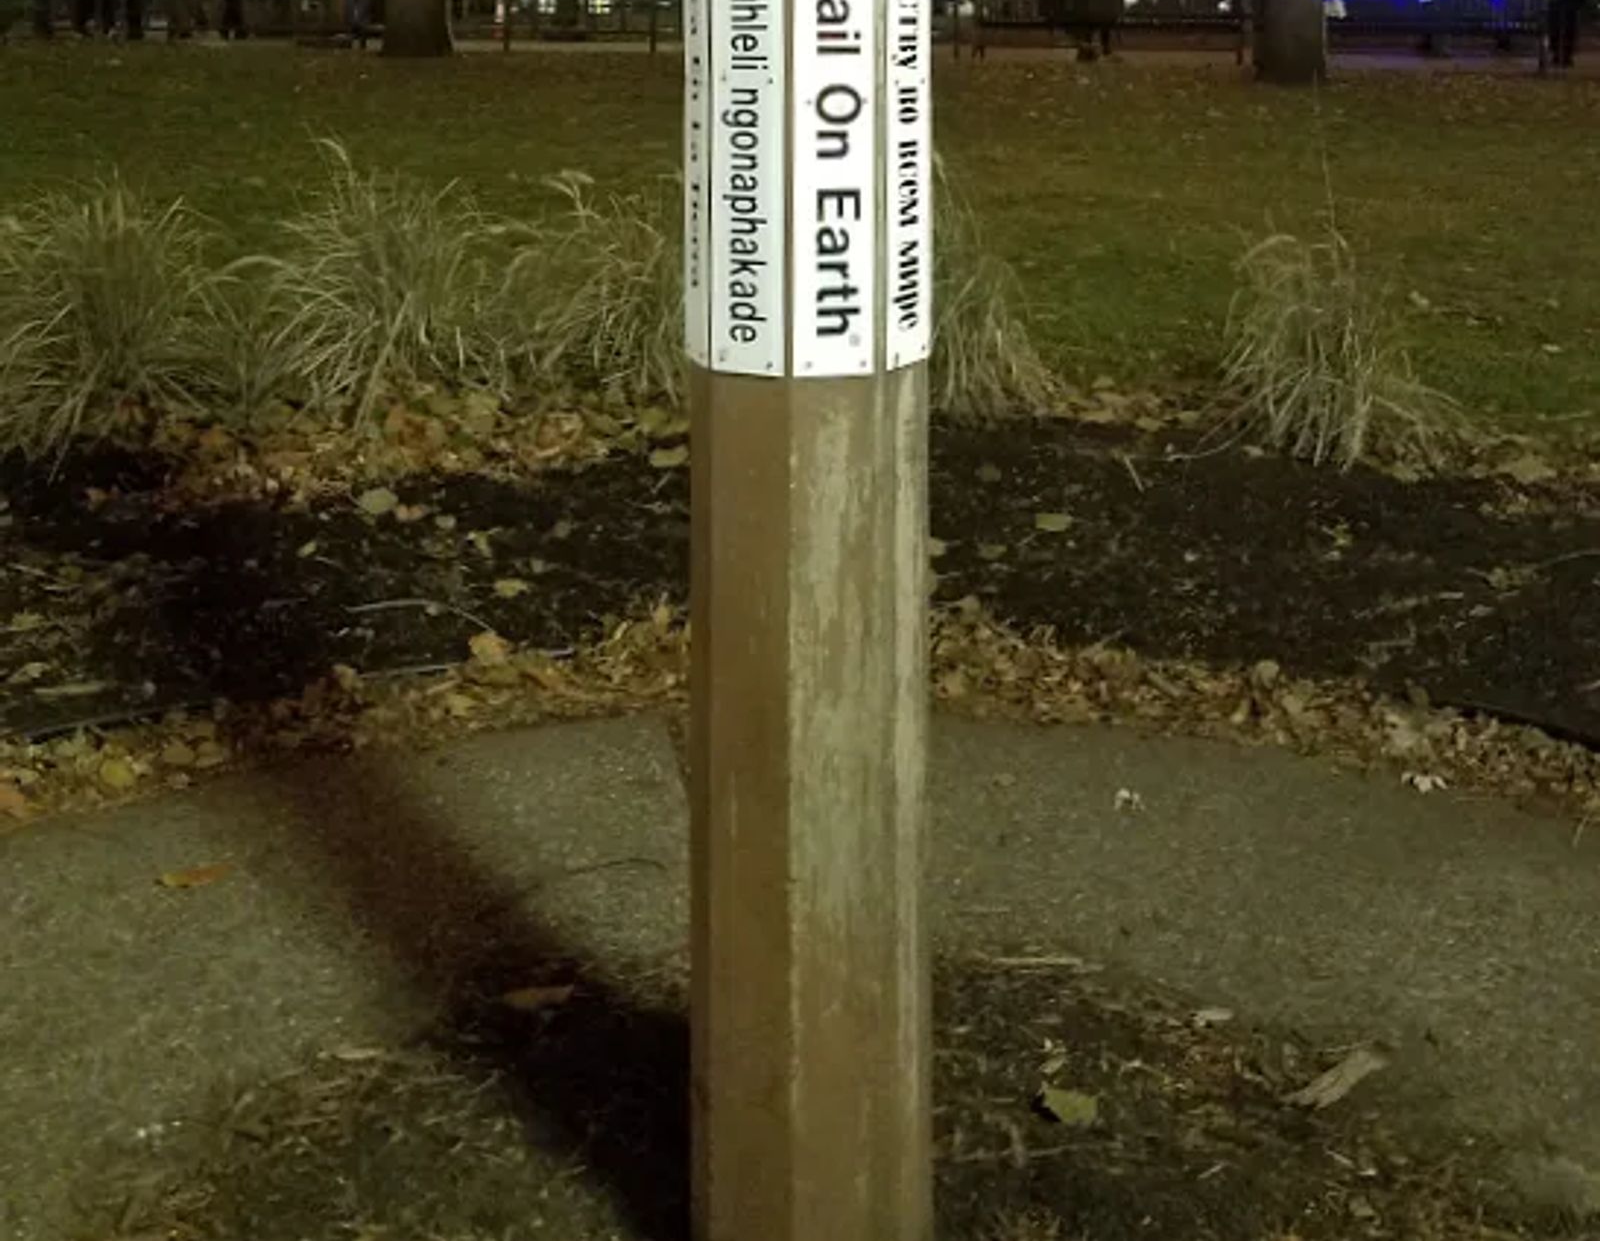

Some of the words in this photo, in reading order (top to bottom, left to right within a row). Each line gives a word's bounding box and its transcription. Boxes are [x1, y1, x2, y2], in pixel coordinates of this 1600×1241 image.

[815, 84, 863, 159] On
[897, 85, 919, 125] во
[721, 88, 768, 343] ngonaphakade
[892, 240, 919, 331] мире
